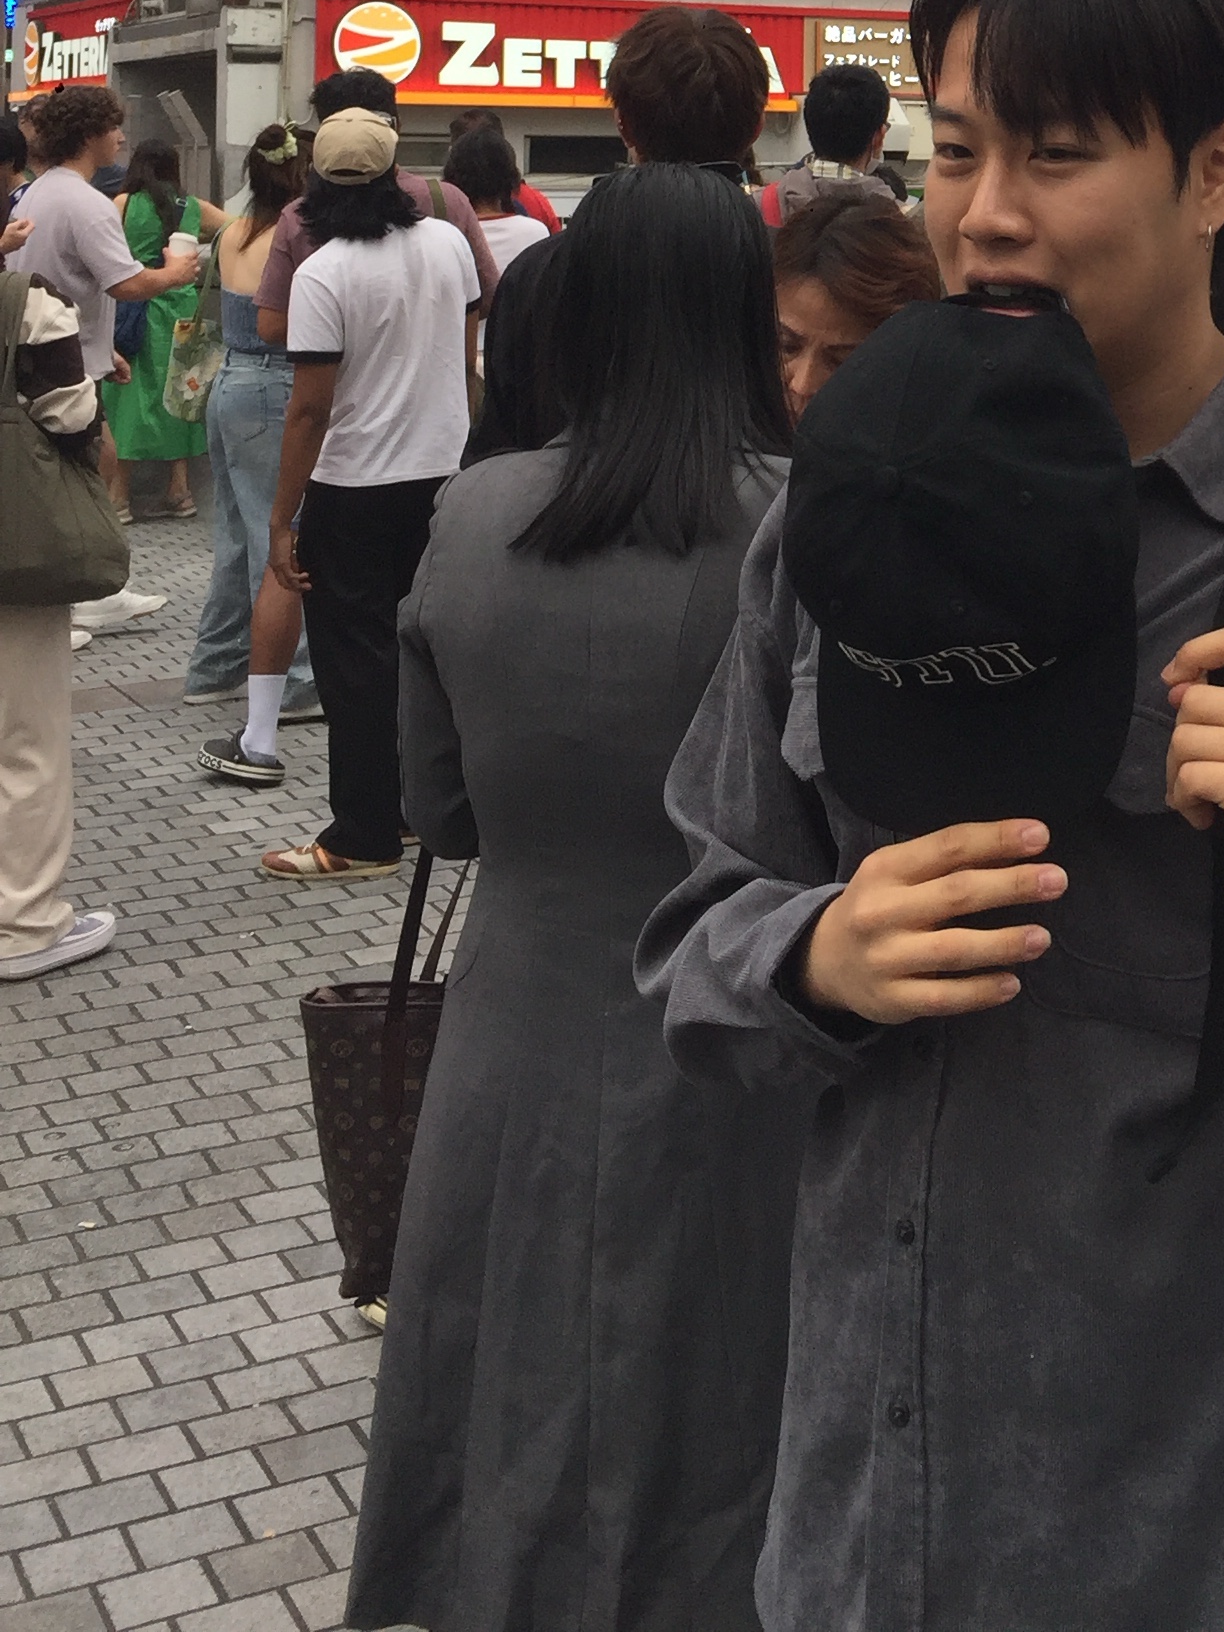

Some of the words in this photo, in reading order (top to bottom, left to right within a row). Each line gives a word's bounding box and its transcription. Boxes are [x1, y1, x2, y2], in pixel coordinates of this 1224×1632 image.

[824, 25, 912, 44] 絶品バーガ
[41, 31, 108, 82] ZETTERI
